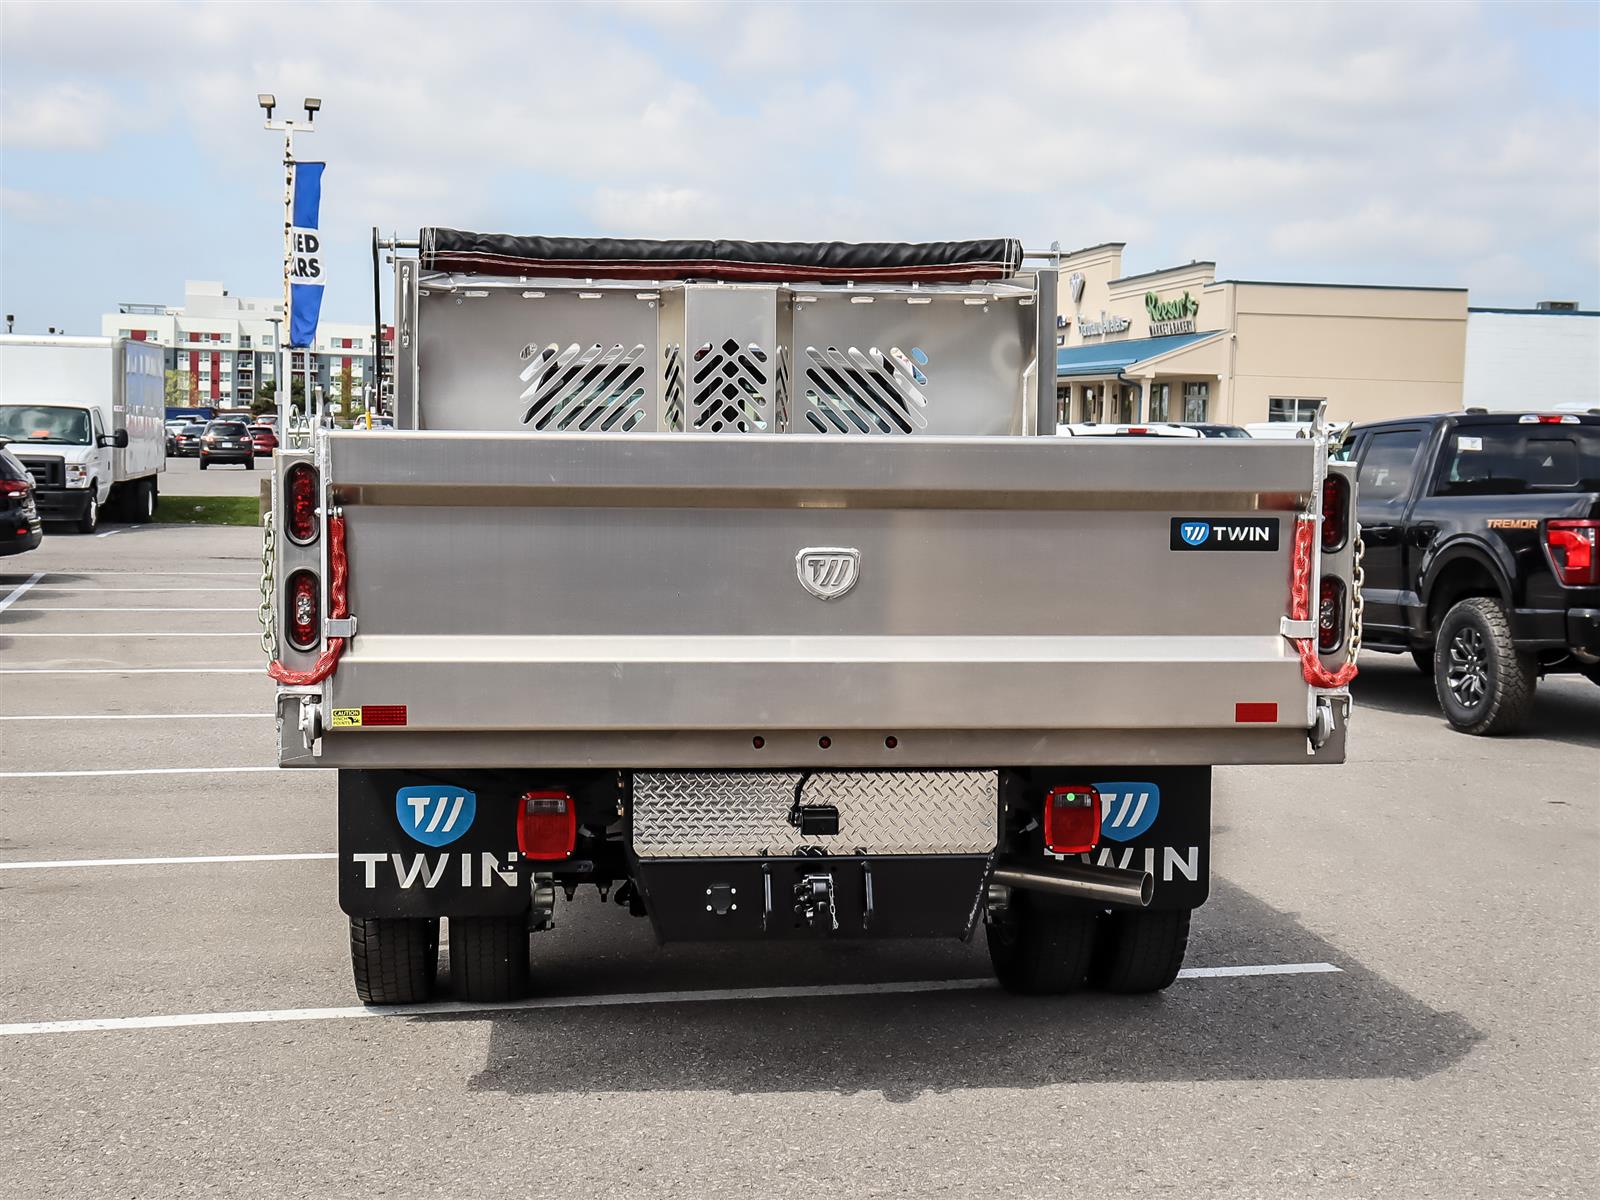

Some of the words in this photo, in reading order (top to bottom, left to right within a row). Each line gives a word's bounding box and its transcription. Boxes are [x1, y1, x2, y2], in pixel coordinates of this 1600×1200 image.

[1145, 289, 1199, 322] Reesor's
[1213, 526, 1270, 541] TWIN
[1486, 519, 1539, 529] TREMOR
[353, 851, 518, 889] TWIN
